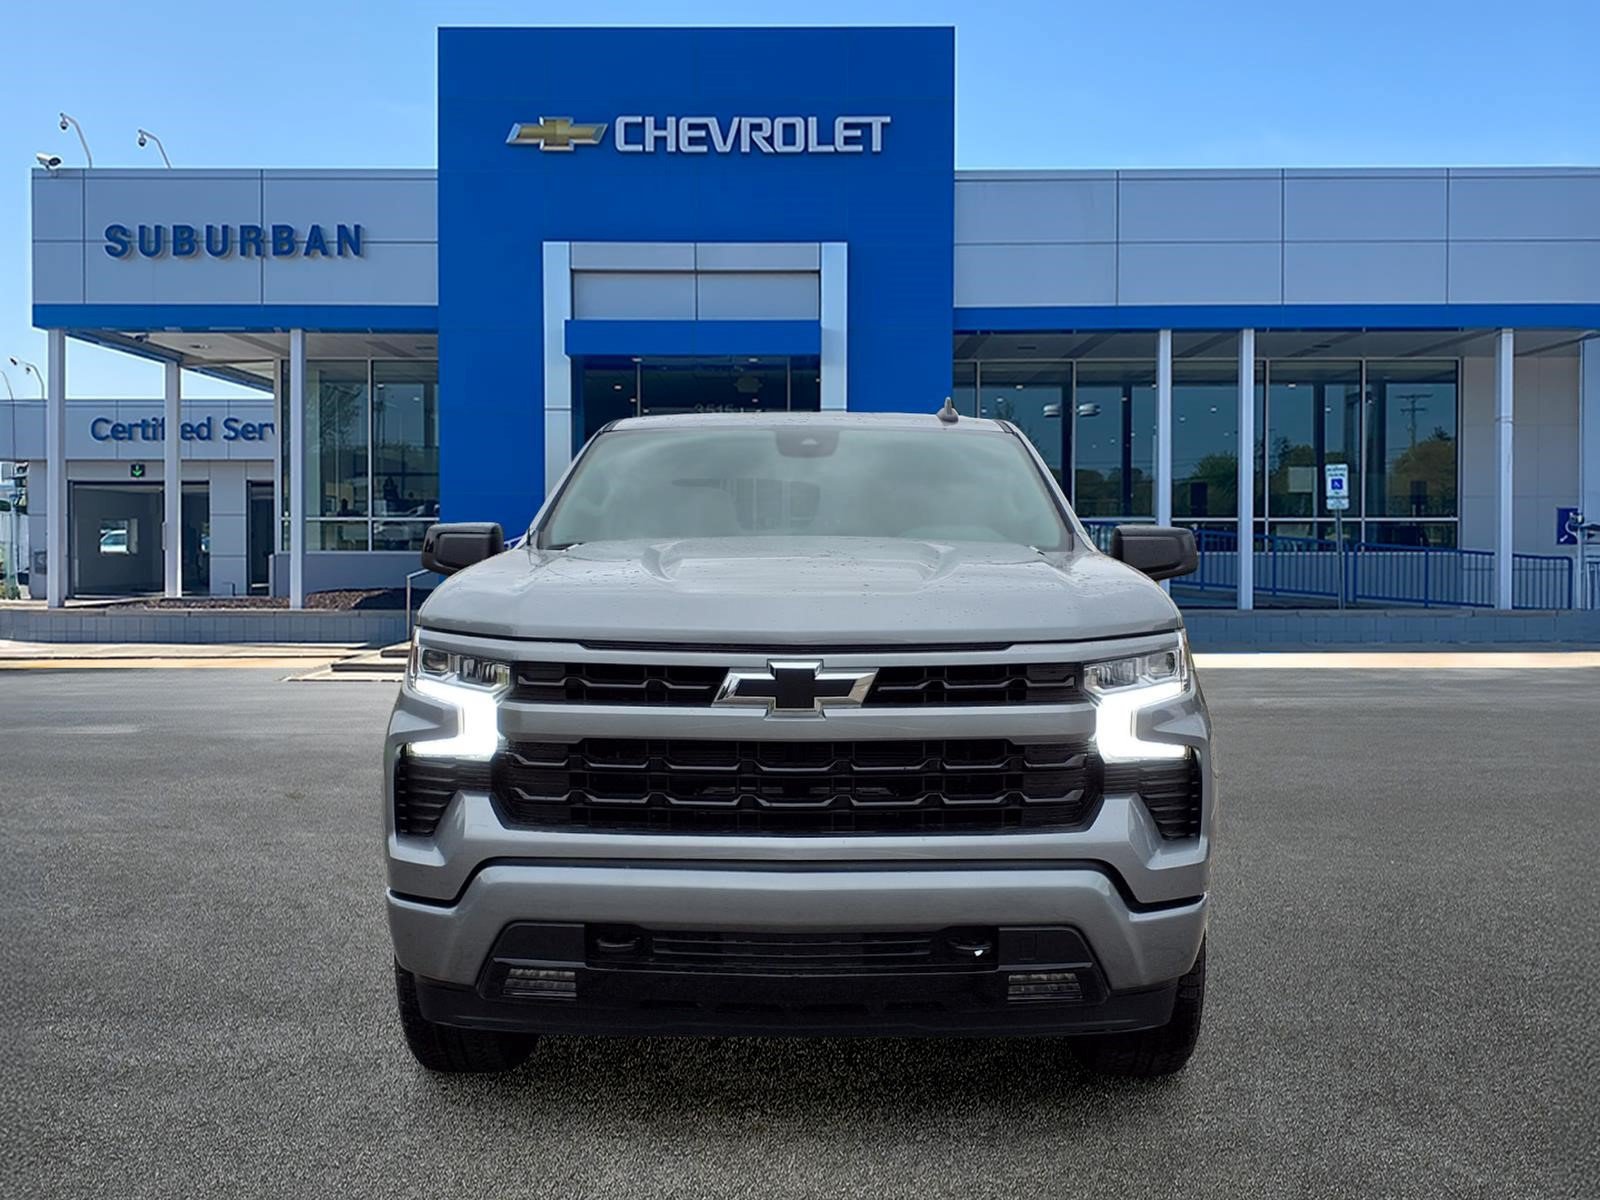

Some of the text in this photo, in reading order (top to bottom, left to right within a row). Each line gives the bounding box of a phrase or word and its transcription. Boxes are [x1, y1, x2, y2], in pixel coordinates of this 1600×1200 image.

[614, 115, 892, 154] CHEVROLET
[104, 223, 363, 258] SUBURBAN
[90, 416, 212, 441] Certifed
